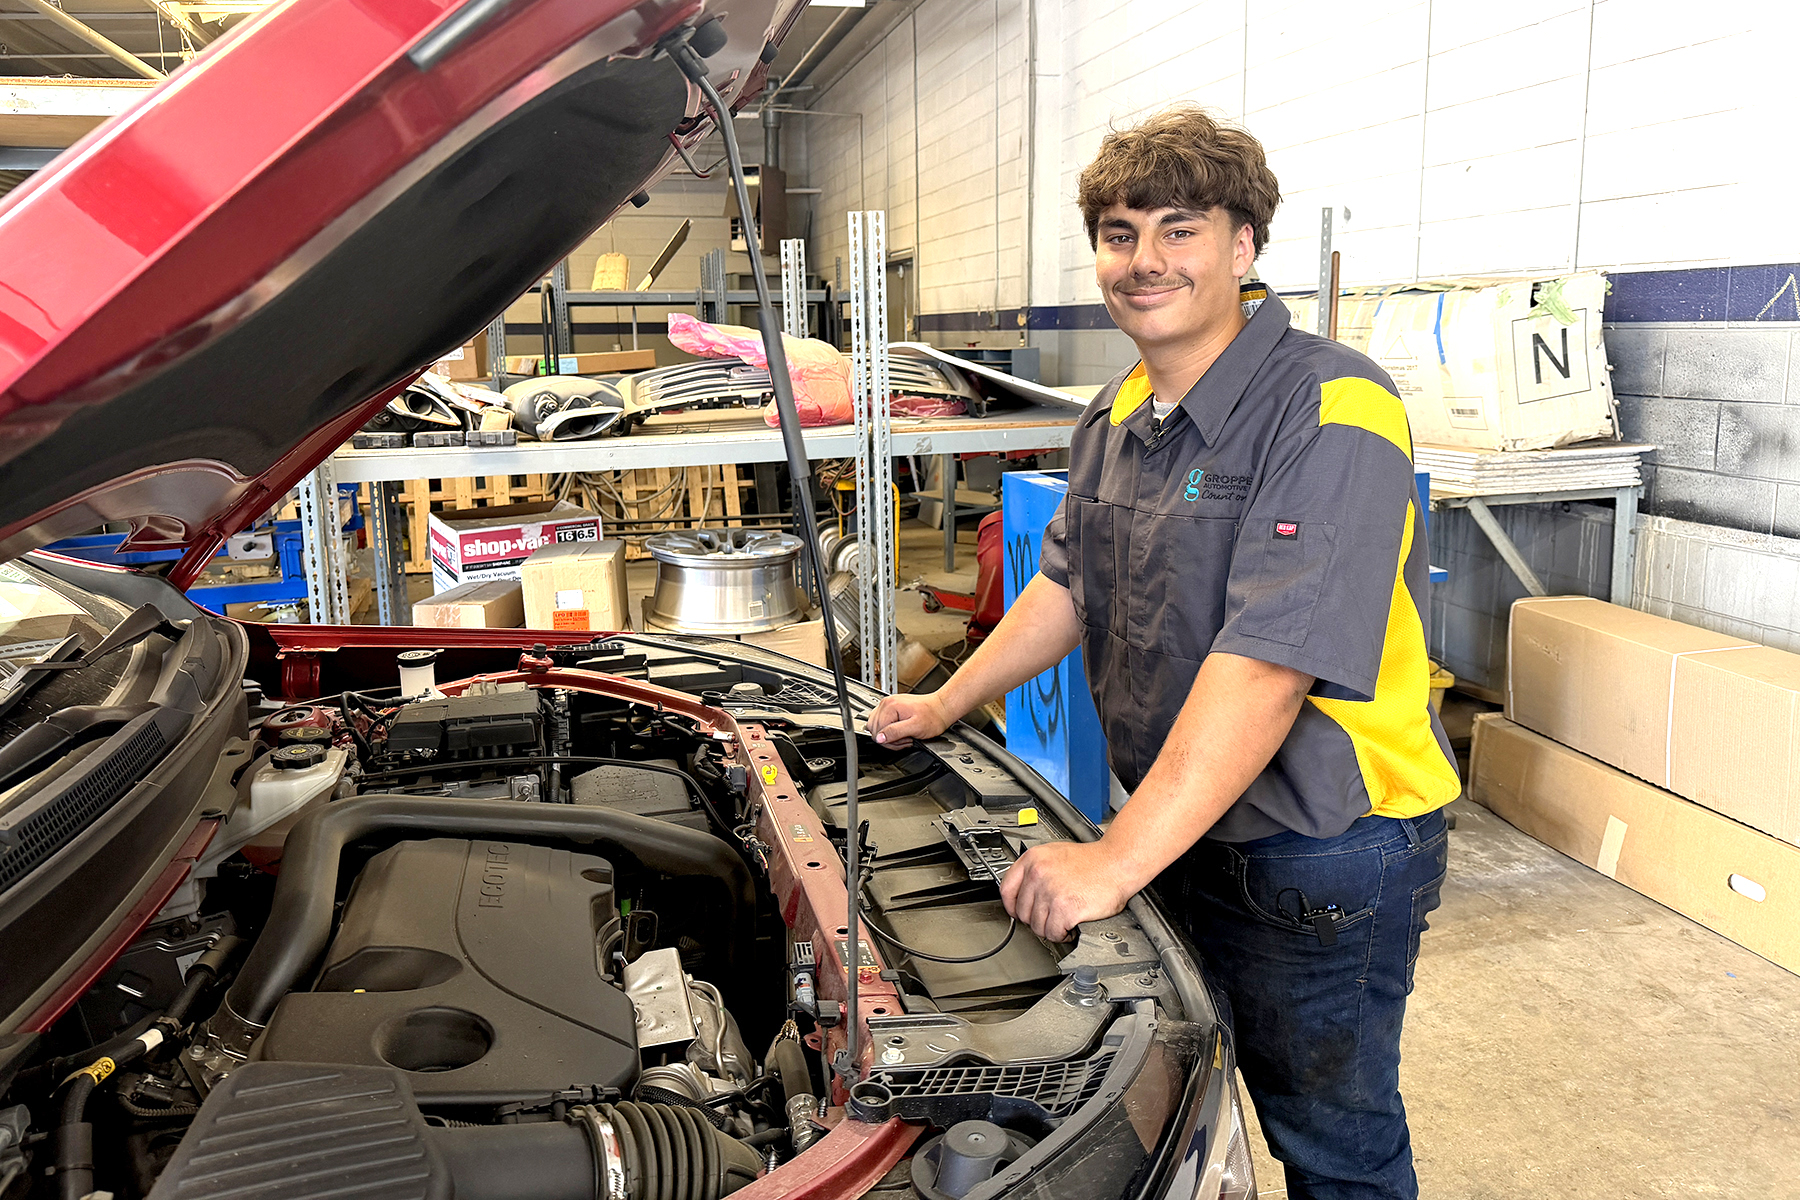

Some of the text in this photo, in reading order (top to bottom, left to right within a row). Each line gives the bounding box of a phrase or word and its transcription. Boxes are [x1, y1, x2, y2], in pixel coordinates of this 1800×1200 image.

[1532, 328, 1570, 384] N
[1203, 483, 1248, 491] AUTOMOTIVE
[1201, 490, 1234, 501] Count
[559, 529, 595, 542] 16 6.5
[478, 844, 510, 909] ECOTEC
